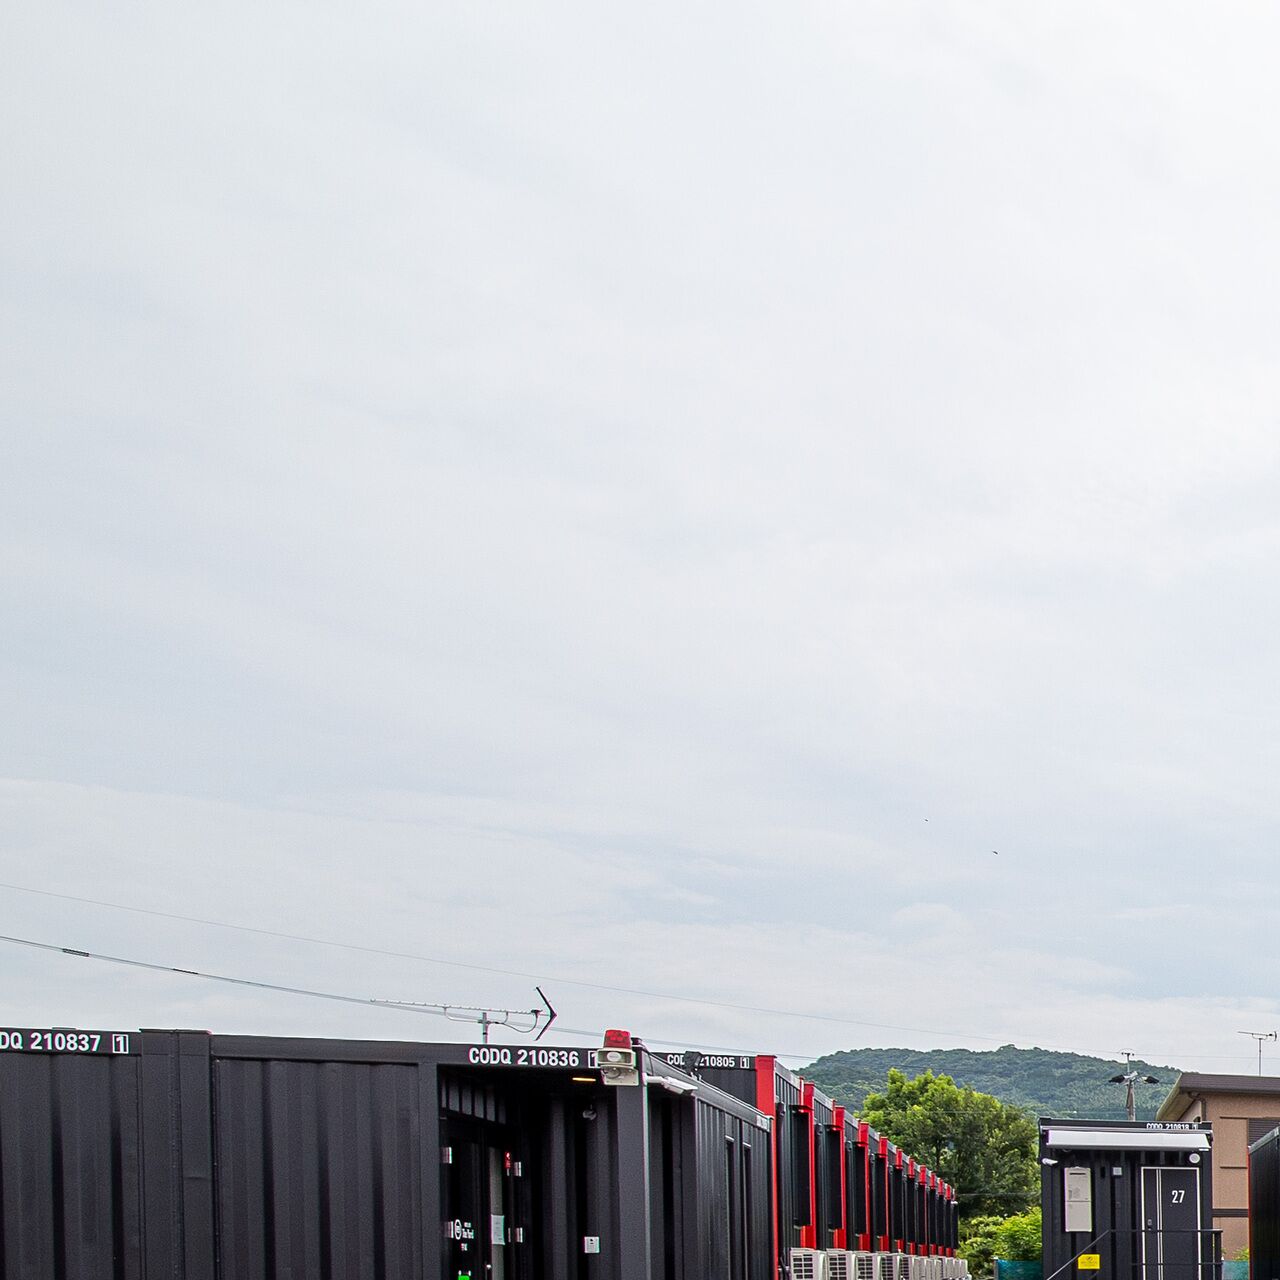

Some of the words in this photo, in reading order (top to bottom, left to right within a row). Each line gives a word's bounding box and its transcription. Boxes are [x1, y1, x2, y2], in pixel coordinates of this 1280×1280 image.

[30, 1031, 101, 1052] 210837
[469, 1047, 512, 1065] CODQ
[517, 1050, 579, 1067] 210836
[1171, 1190, 1185, 1203] 27
